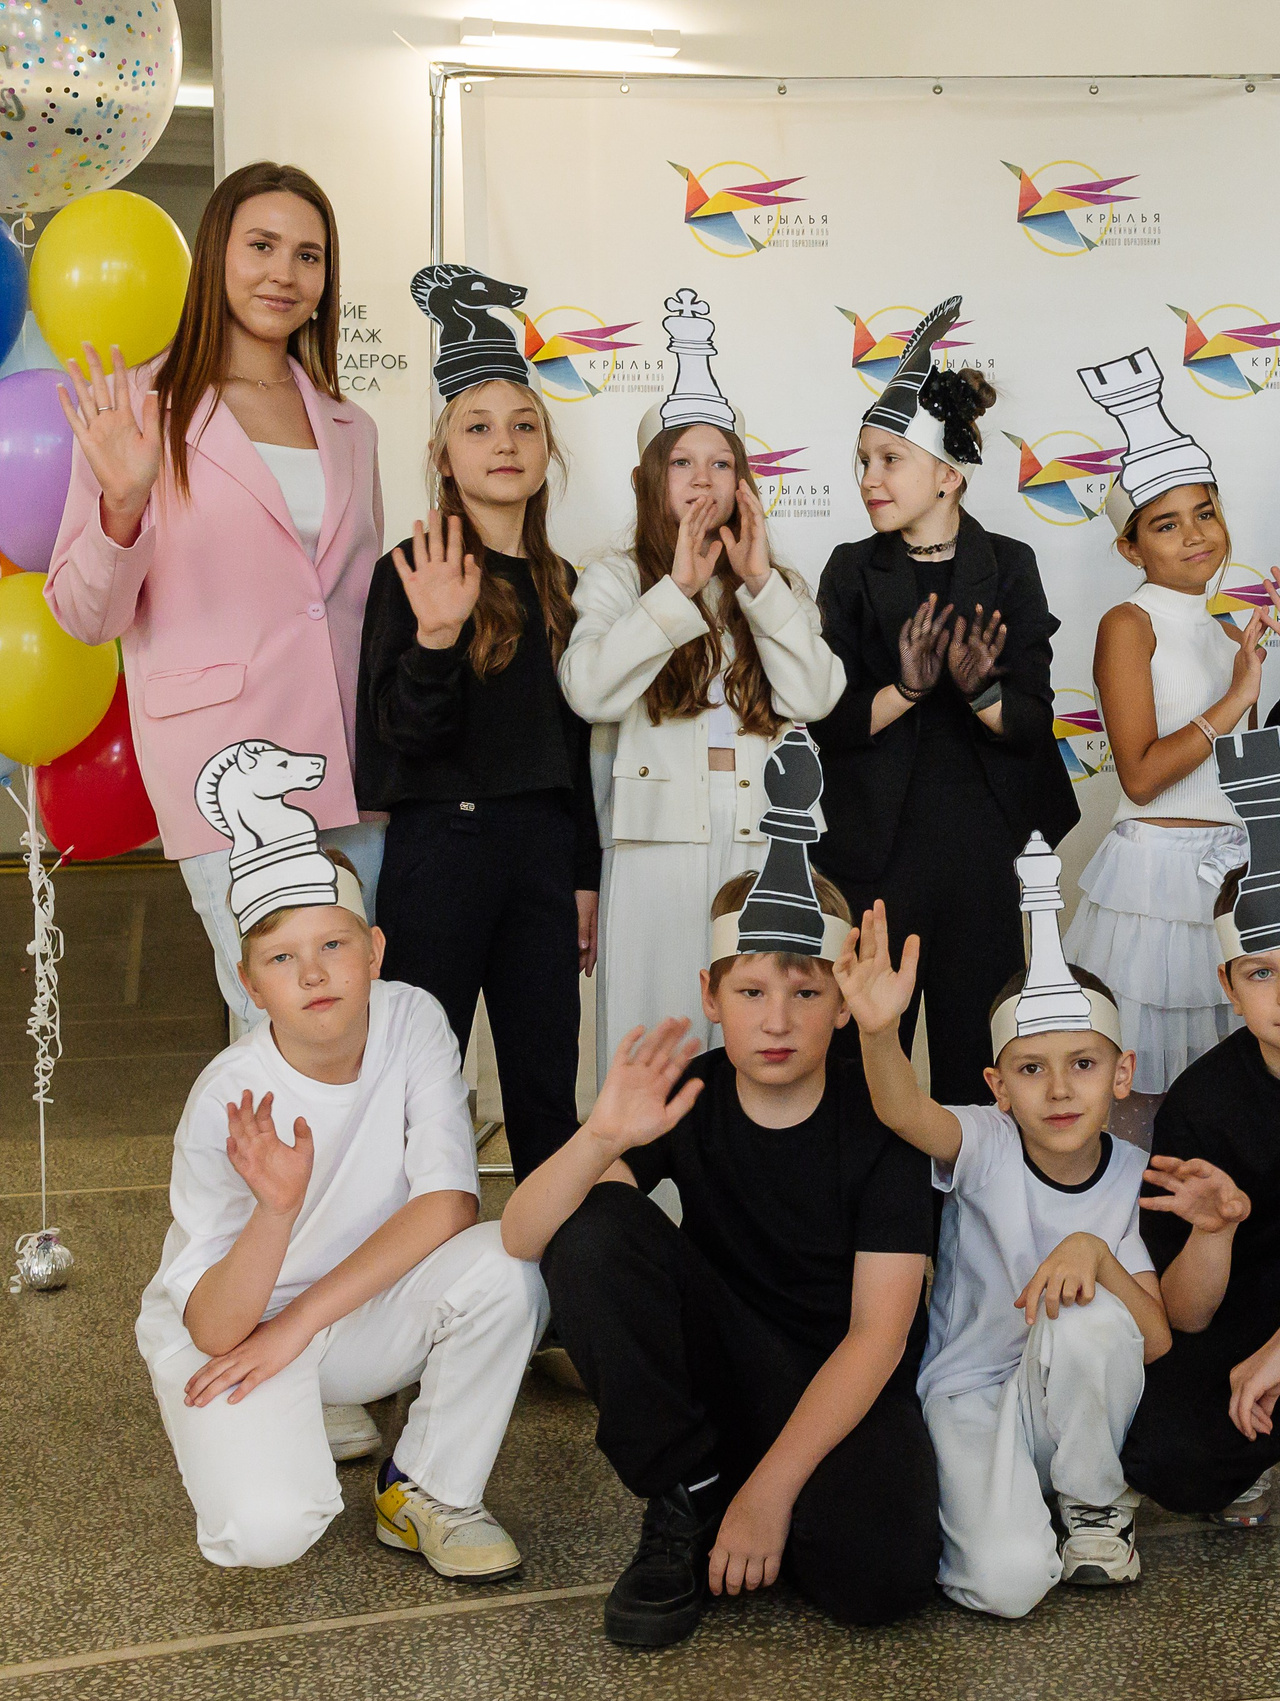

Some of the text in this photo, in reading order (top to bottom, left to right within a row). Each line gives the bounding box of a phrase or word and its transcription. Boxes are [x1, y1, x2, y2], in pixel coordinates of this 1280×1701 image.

[754, 215, 828, 224] КРЫЛЬЯ
[1086, 213, 1160, 223] КРЫЛЬЯ
[341, 302, 367, 319] ЙЕ
[341, 327, 382, 343] ТАЖ
[337, 353, 408, 370] РДЕРОБ
[589, 360, 663, 369] КРЫЛЬЯ
[934, 359, 995, 368] РЫЛЬЯ
[338, 375, 381, 391] ССА
